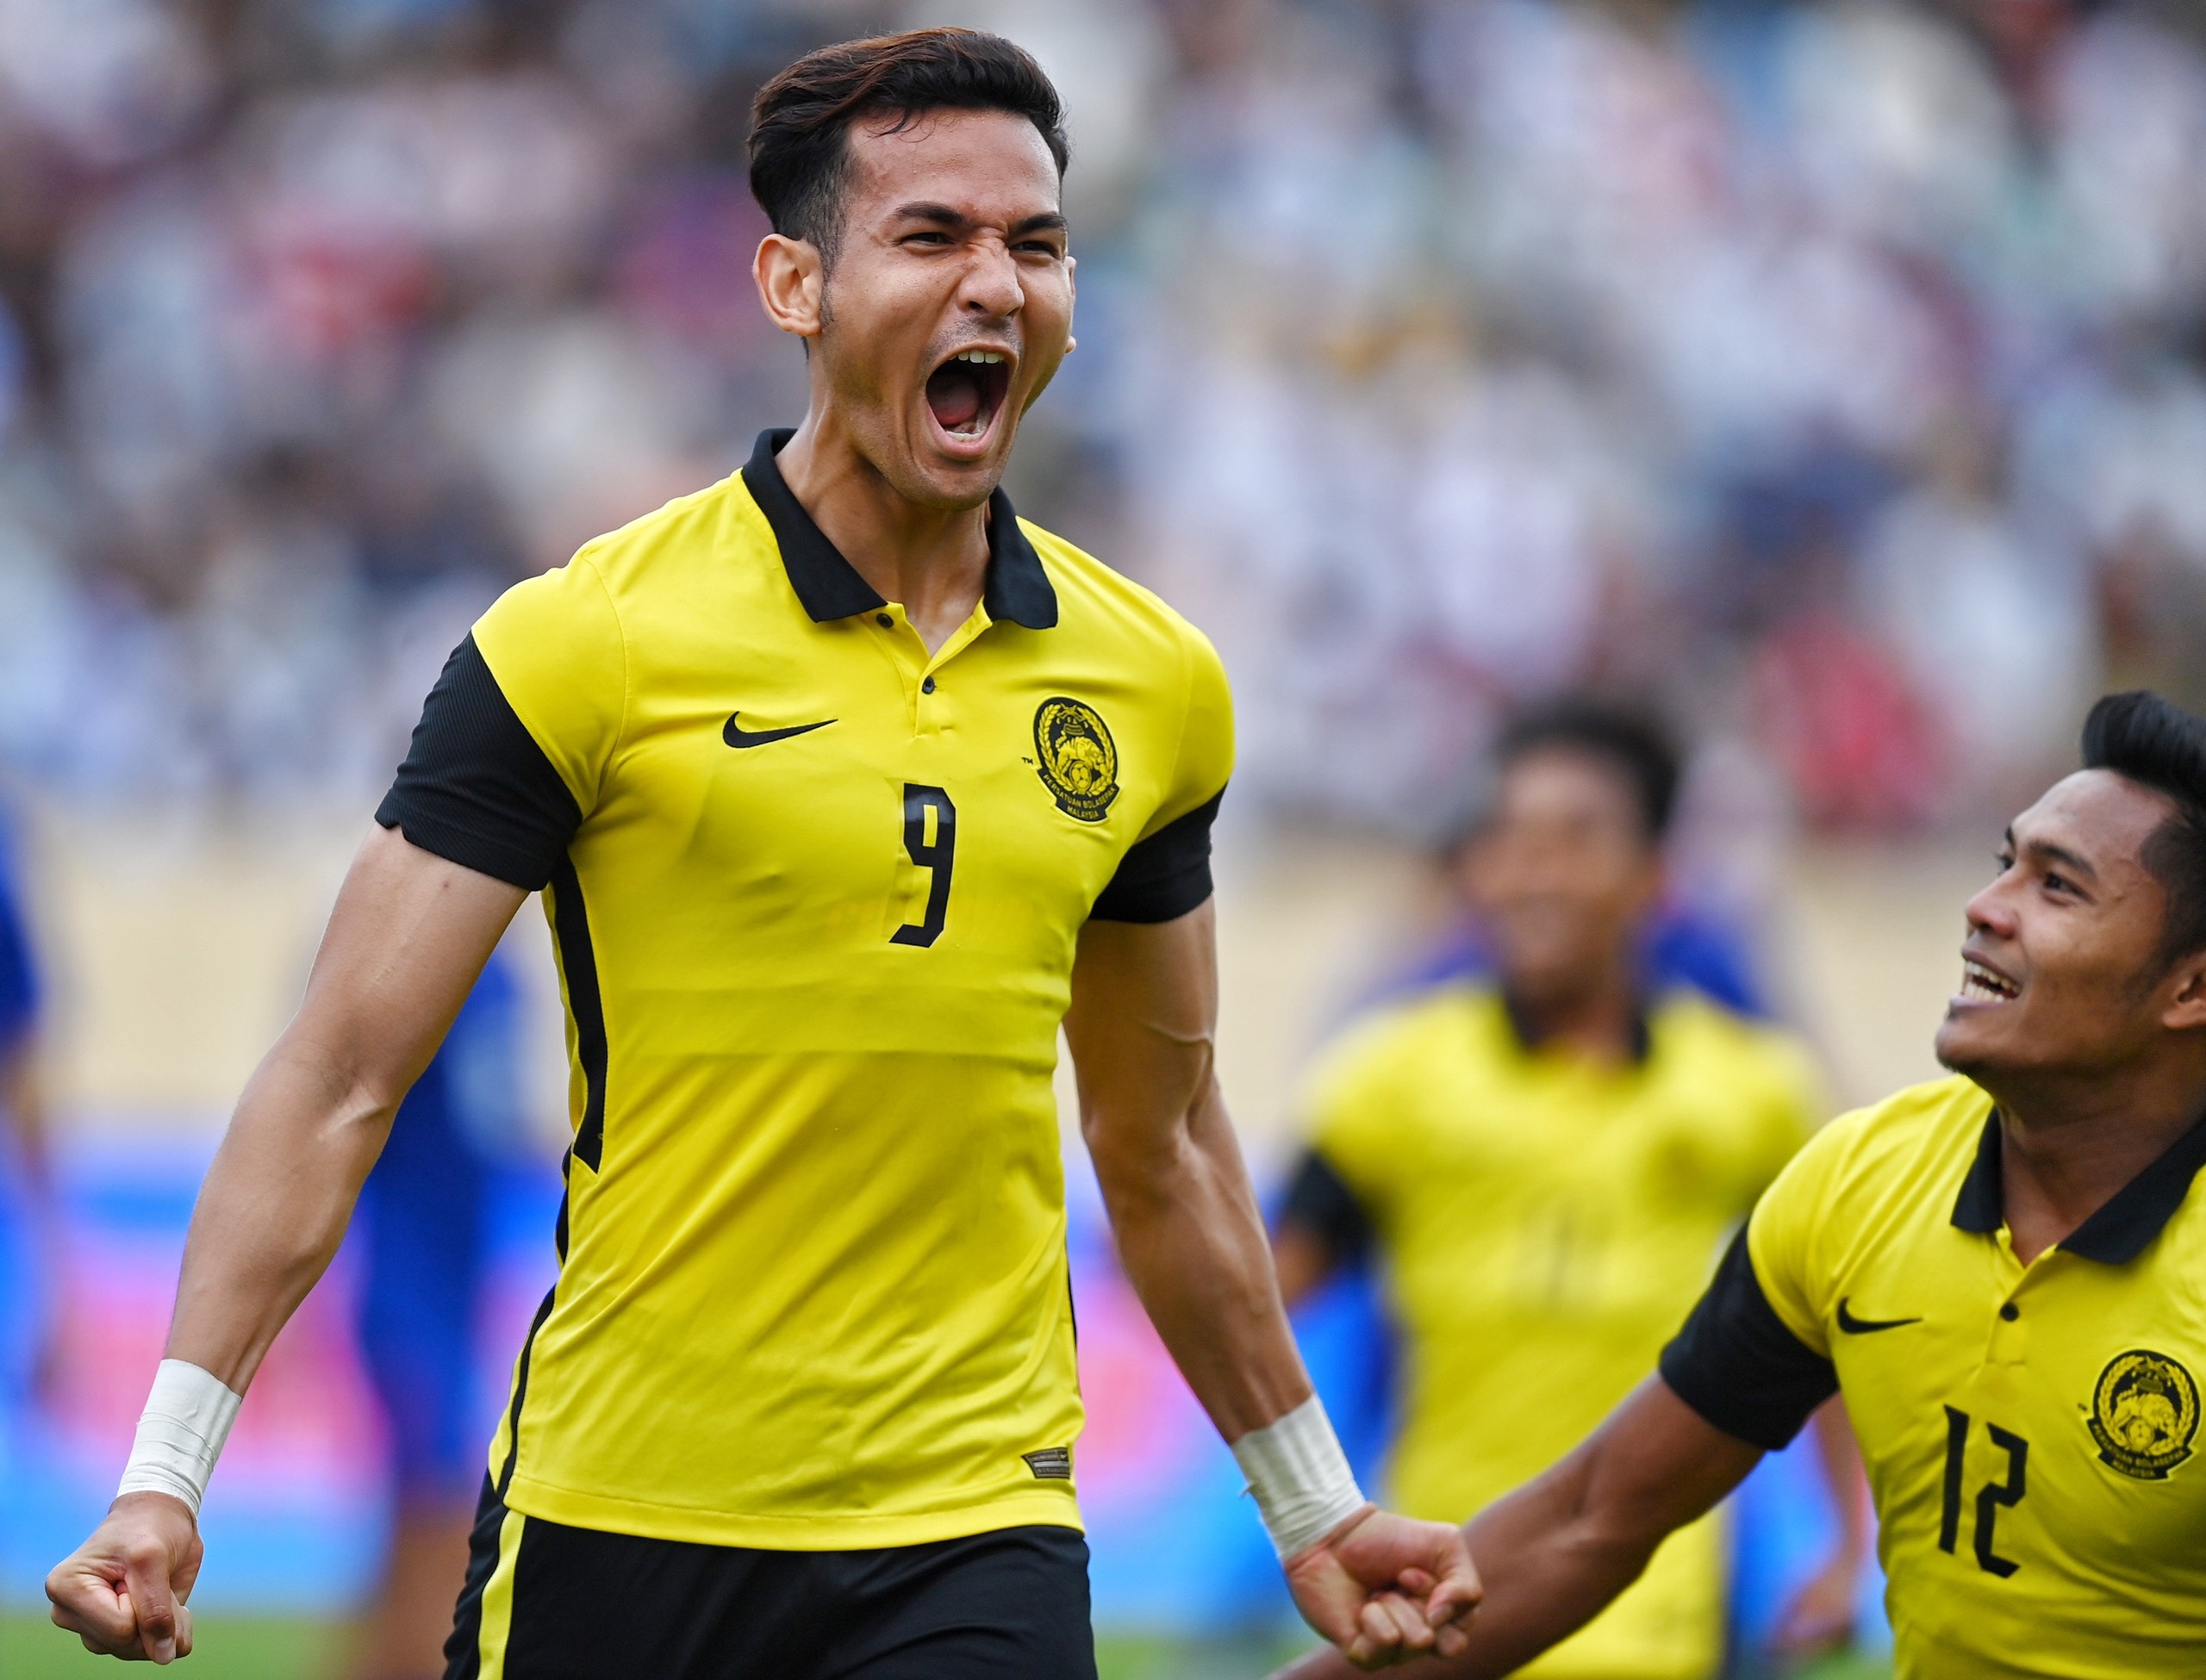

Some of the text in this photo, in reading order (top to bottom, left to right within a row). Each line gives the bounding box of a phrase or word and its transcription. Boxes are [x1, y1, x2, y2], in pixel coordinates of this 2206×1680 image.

[1043, 774, 1117, 809] PERSATUAN BOLASEPAK
[1066, 806, 1100, 819] MALAYSIA
[888, 782, 957, 948] 9
[1938, 1403, 2028, 1579] 12
